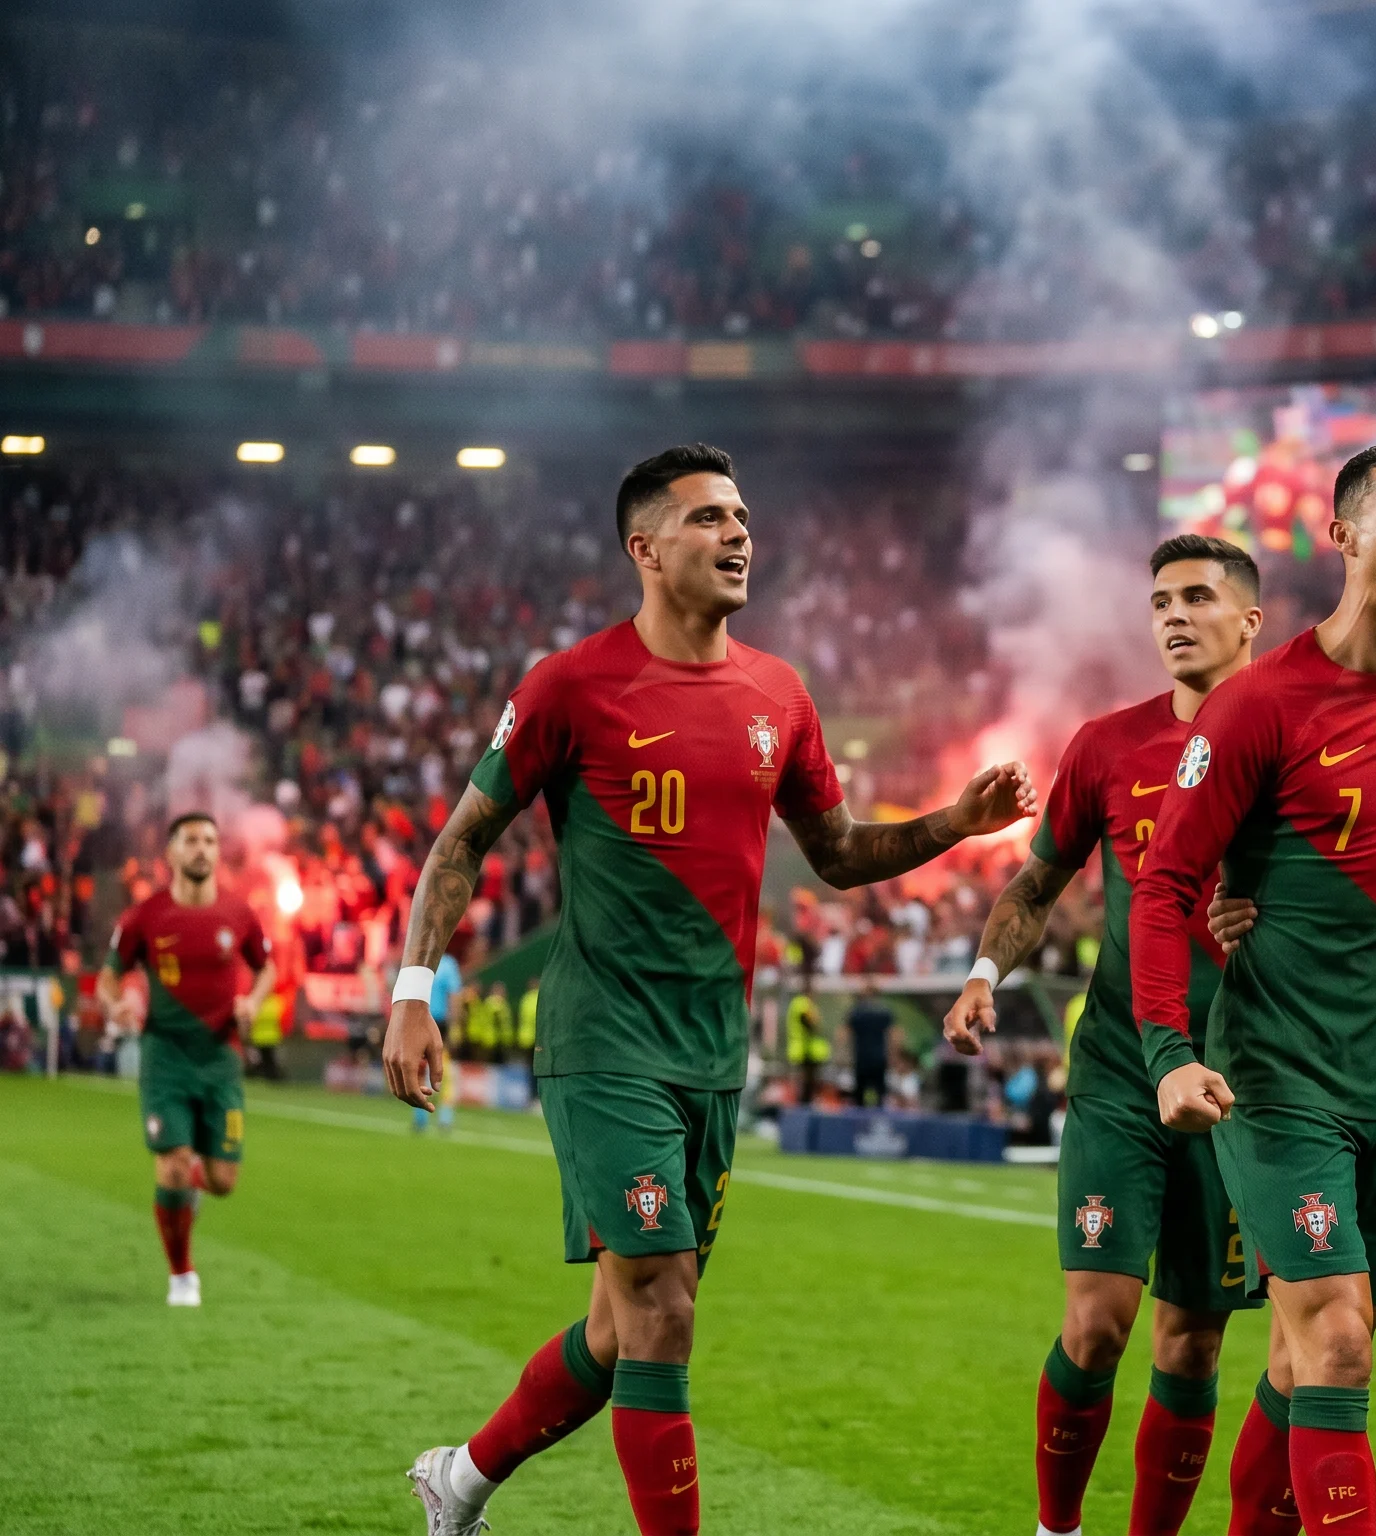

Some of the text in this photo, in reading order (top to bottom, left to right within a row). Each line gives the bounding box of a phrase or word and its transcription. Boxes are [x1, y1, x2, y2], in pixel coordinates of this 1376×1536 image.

[630, 769, 685, 834] 20
[1335, 787, 1362, 852] 7
[706, 1171, 729, 1231] 2
